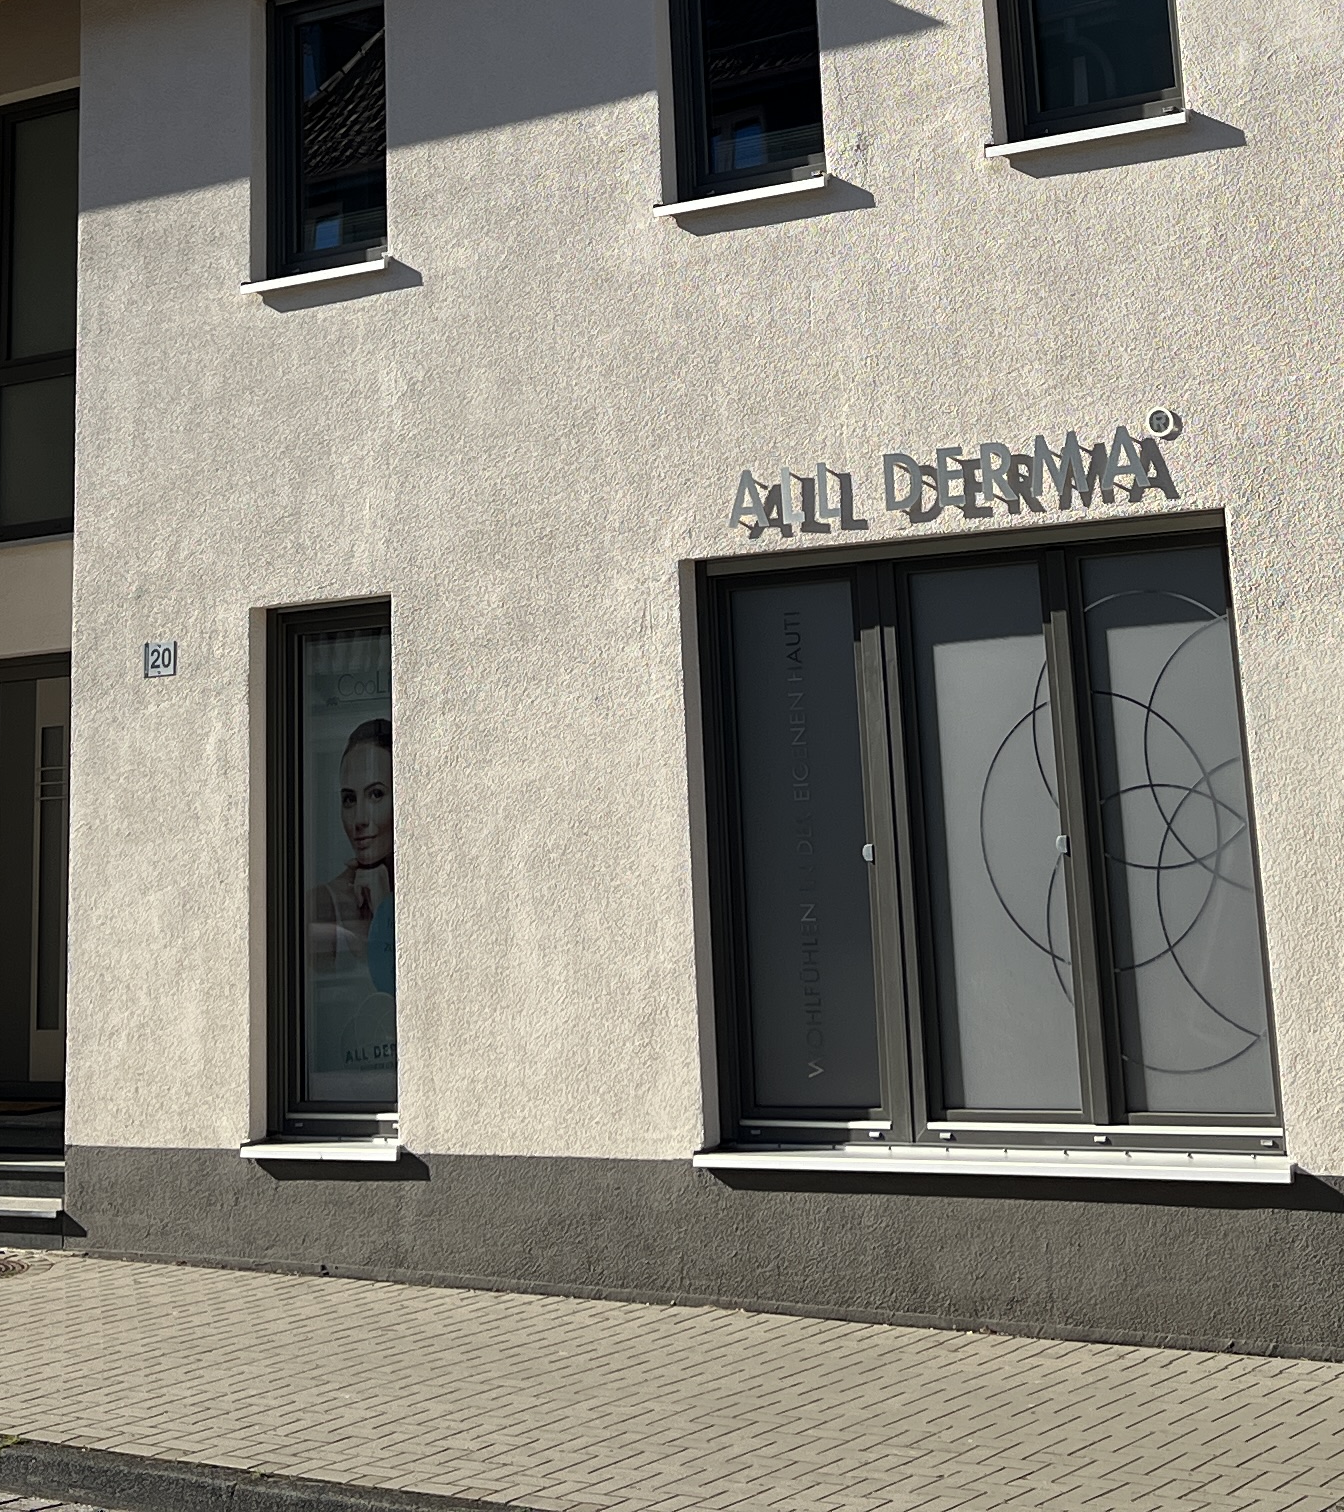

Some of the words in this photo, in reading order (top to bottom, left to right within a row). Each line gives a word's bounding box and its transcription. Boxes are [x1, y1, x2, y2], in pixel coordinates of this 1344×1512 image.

[730, 462, 840, 528] ALL
[150, 647, 172, 669] 20
[346, 1048, 368, 1063] ALL
